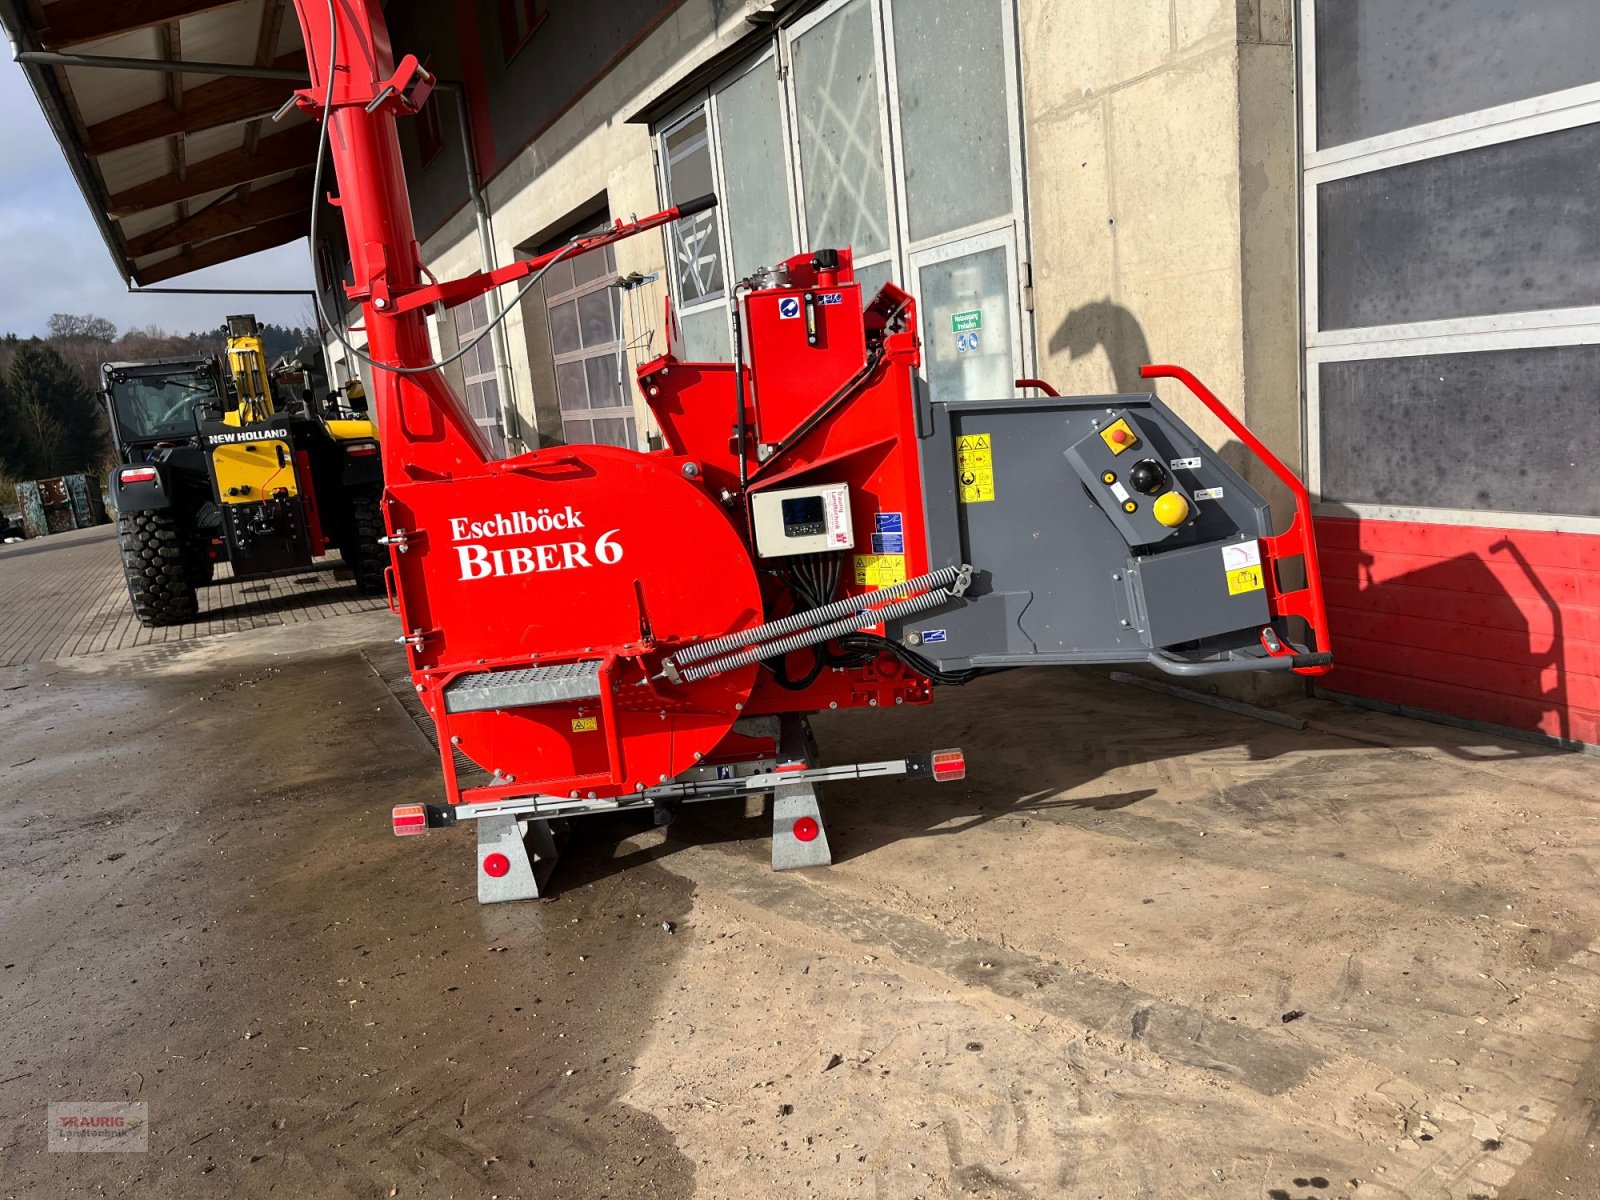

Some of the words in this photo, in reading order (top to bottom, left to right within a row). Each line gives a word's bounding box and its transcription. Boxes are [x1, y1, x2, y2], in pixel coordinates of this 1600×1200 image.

[209, 433, 235, 444] NEW
[236, 428, 288, 441] HOLLAND
[448, 506, 585, 541] Eschlböck
[594, 528, 624, 564] 6
